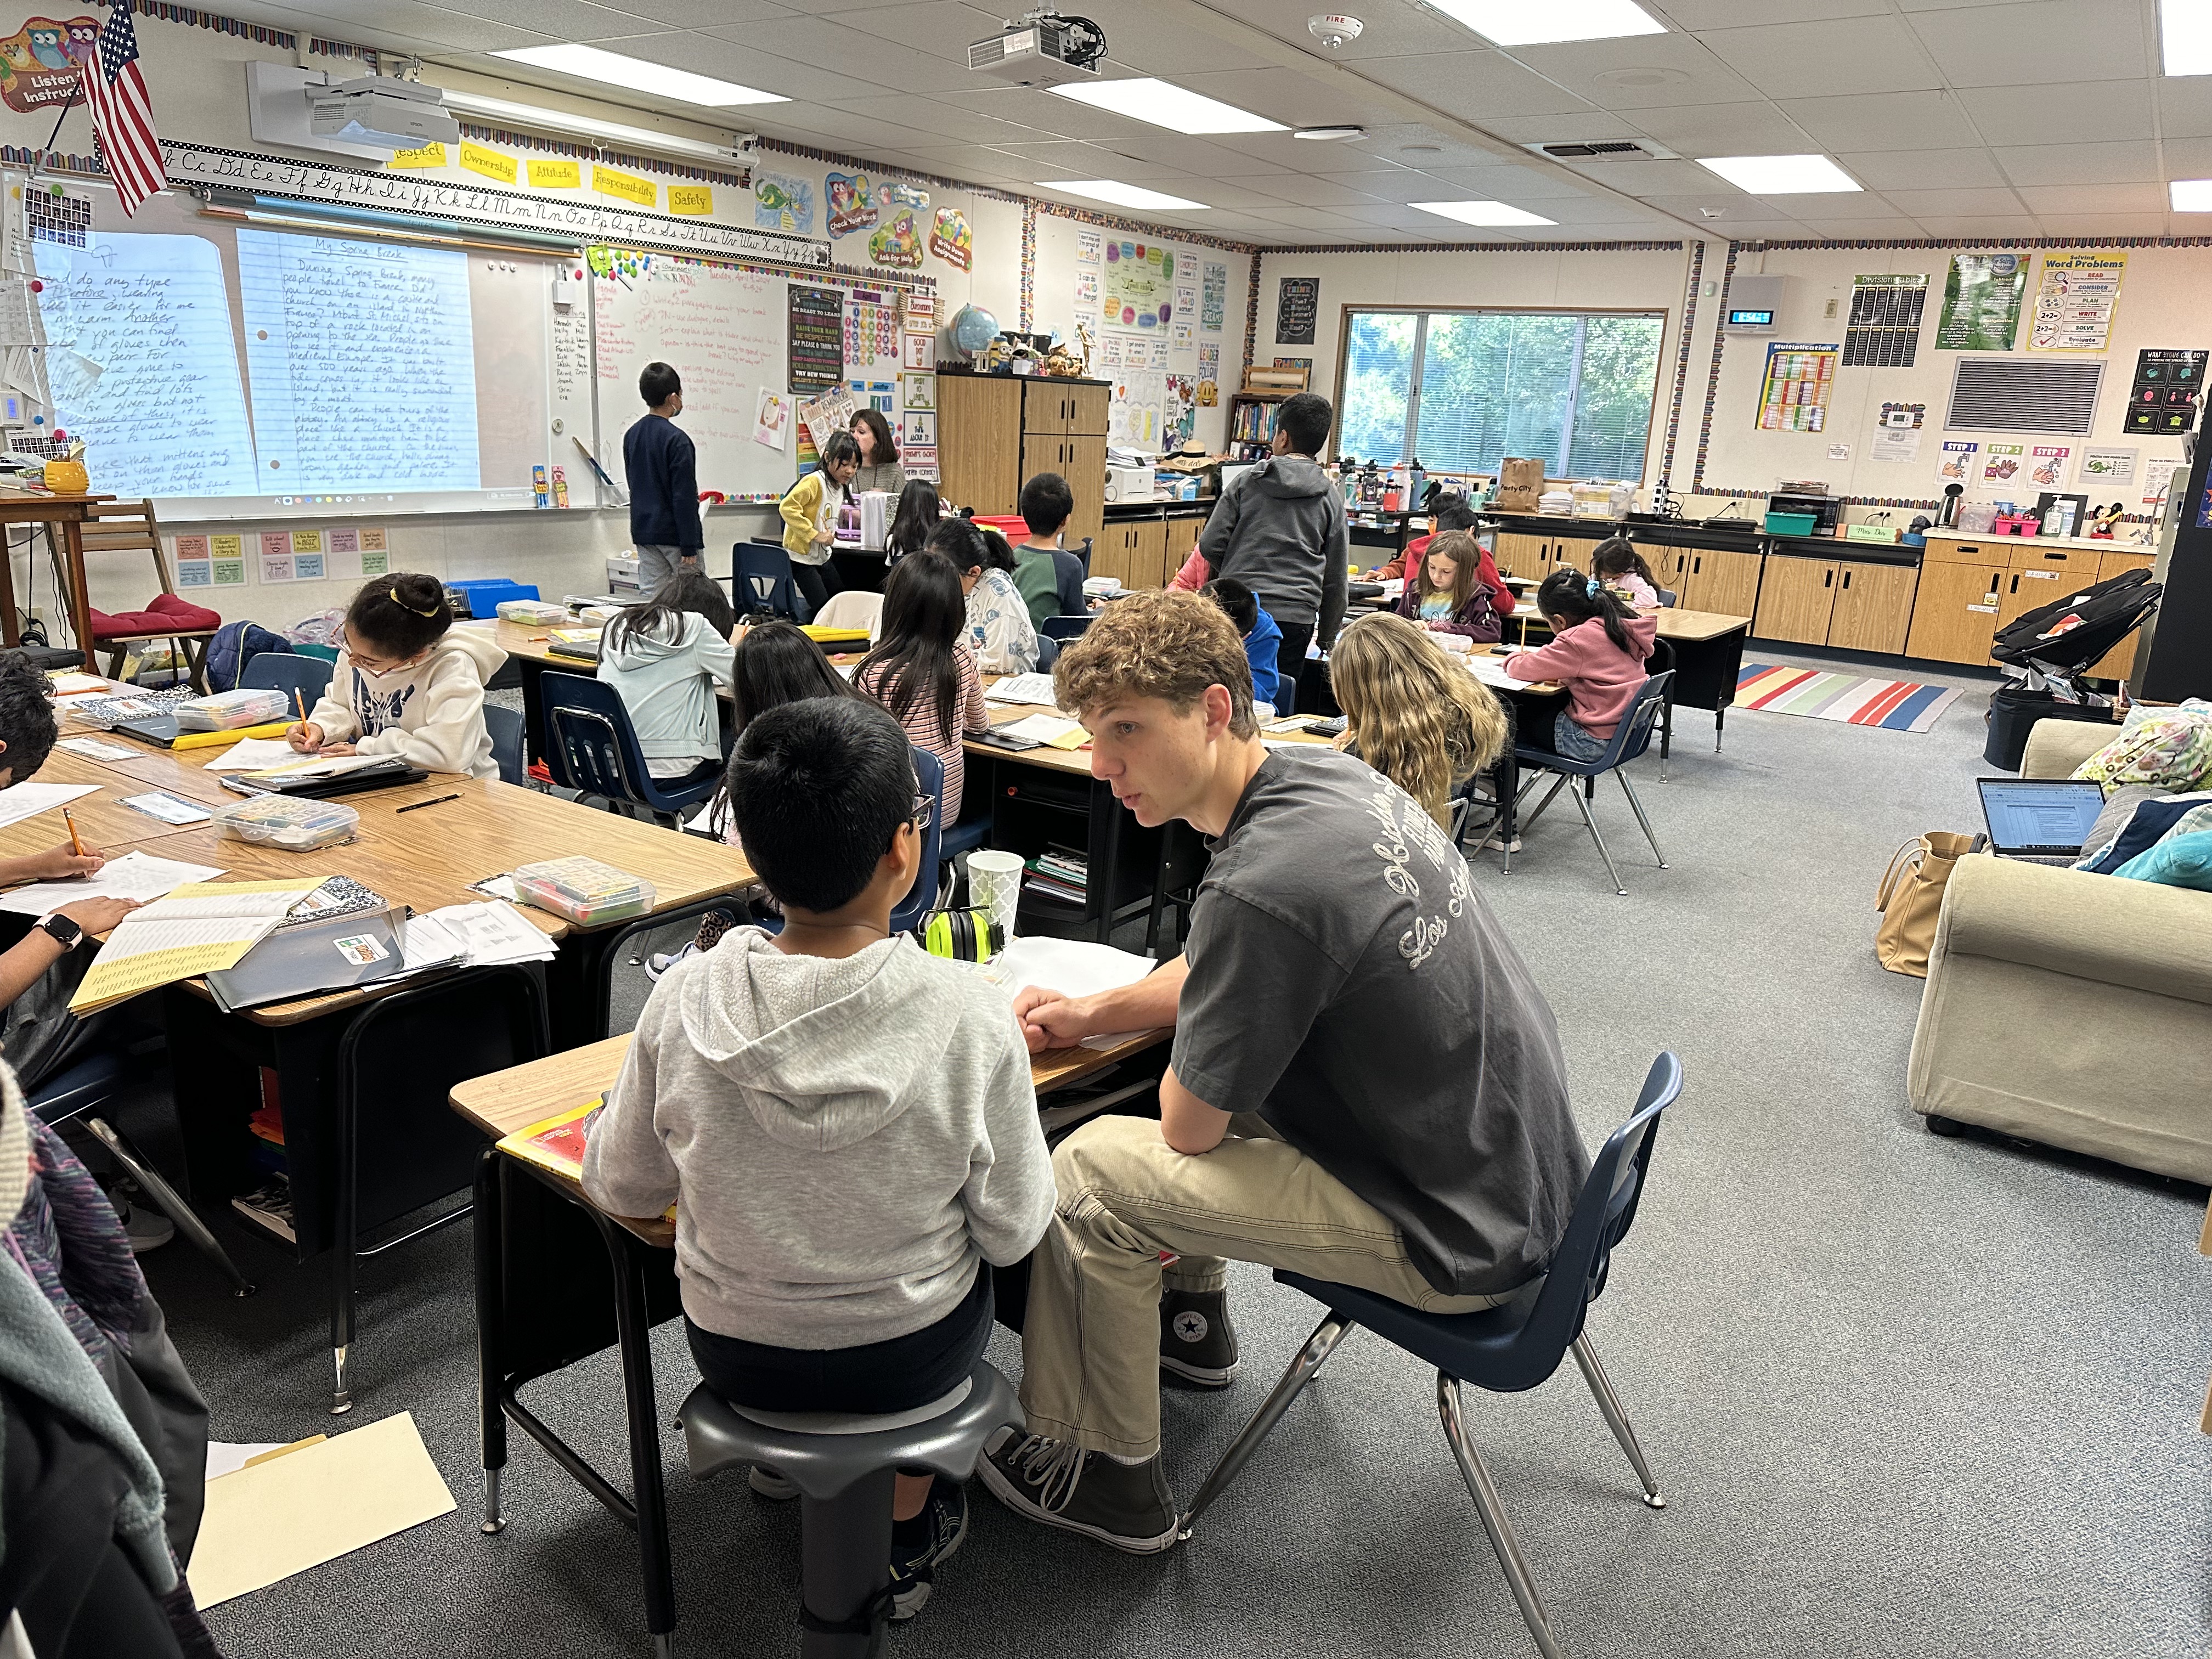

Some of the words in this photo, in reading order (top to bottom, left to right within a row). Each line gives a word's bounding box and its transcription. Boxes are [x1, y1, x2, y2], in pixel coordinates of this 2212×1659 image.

[31, 74, 75, 88] Listen
[464, 150, 514, 177] Ownership
[536, 166, 573, 178] Attitude
[596, 172, 654, 200] Responsibility
[674, 191, 706, 209] Safety
[830, 219, 848, 230] Check
[862, 213, 877, 221] Work
[933, 245, 965, 266] Assignments
[938, 238, 951, 250] Write
[951, 247, 964, 257] Down
[901, 255, 913, 263] Help
[804, 333, 837, 343] RESPECTFUL
[1948, 443, 1968, 451] STEP
[1500, 484, 1518, 493] Party
[1398, 915, 1447, 970] Los
